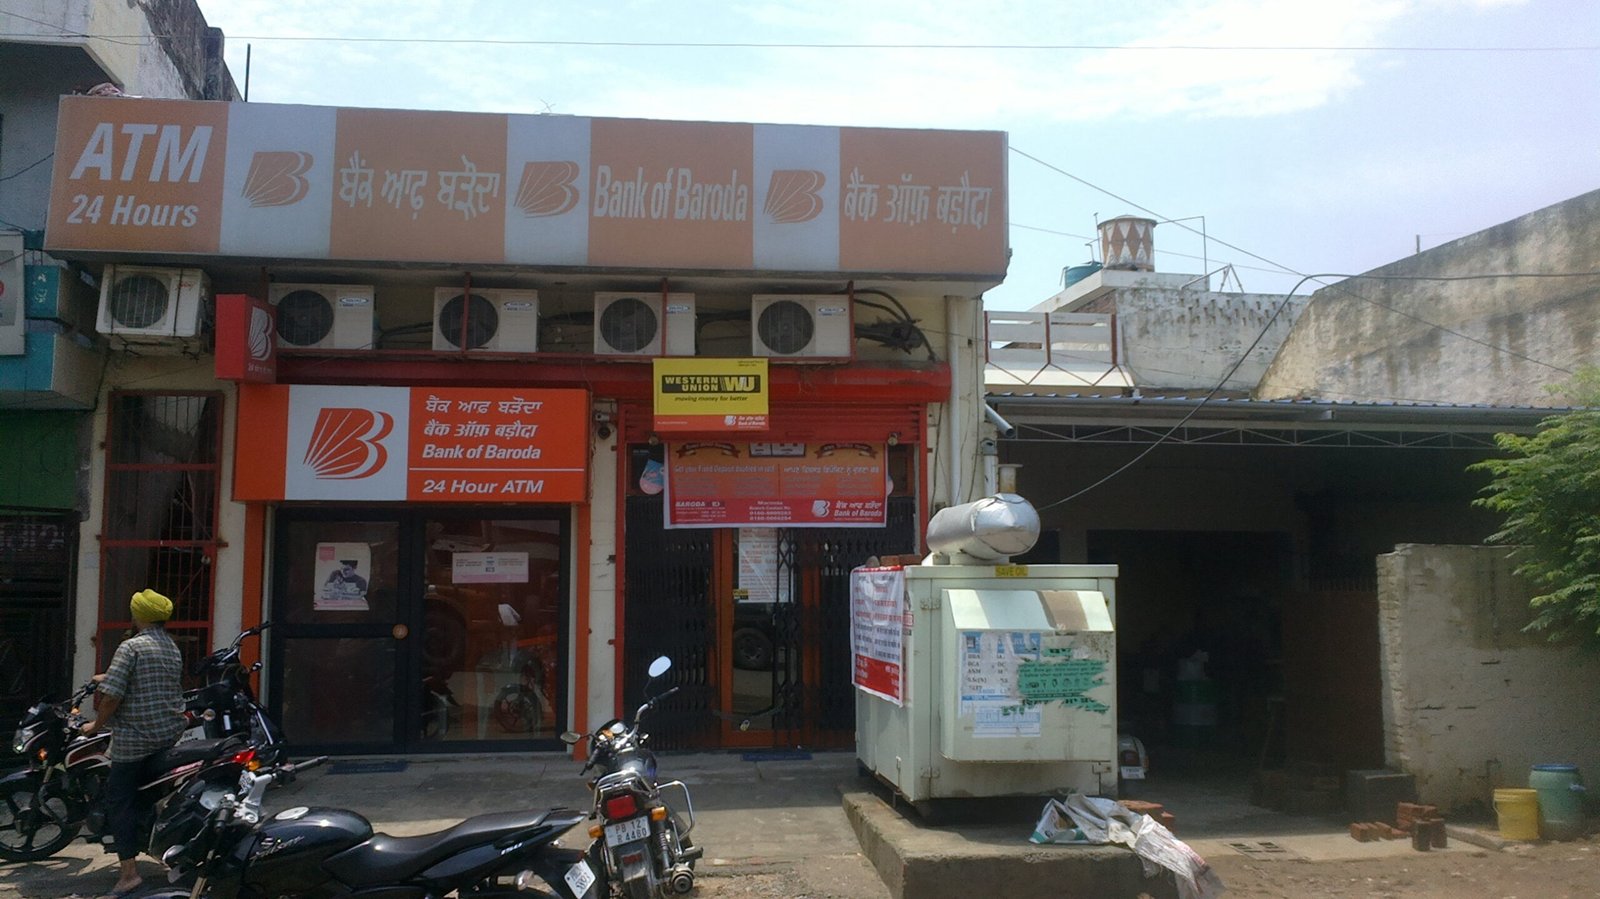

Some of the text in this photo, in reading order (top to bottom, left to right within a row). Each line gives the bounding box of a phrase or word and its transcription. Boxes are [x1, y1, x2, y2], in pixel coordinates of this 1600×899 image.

[68, 122, 213, 183] ATM
[593, 165, 748, 221] Bank of Baroda
[844, 166, 880, 222] बैंक
[936, 170, 993, 234] बड़ौदा
[66, 194, 199, 228] 24 Hours
[665, 376, 755, 392] WESTERN WU
[681, 384, 719, 392] UNION
[425, 394, 452, 413] ਬੈਂਕ
[498, 396, 543, 415] ਬੜੌਦਾ
[424, 419, 451, 436] बैंक
[494, 420, 538, 440] बड़ौदा
[422, 444, 541, 459] Bank of Baroda
[422, 479, 544, 494] 24 Hour ATM
[834, 509, 882, 517] Bank of Baroda
[615, 818, 641, 834] PB 12
